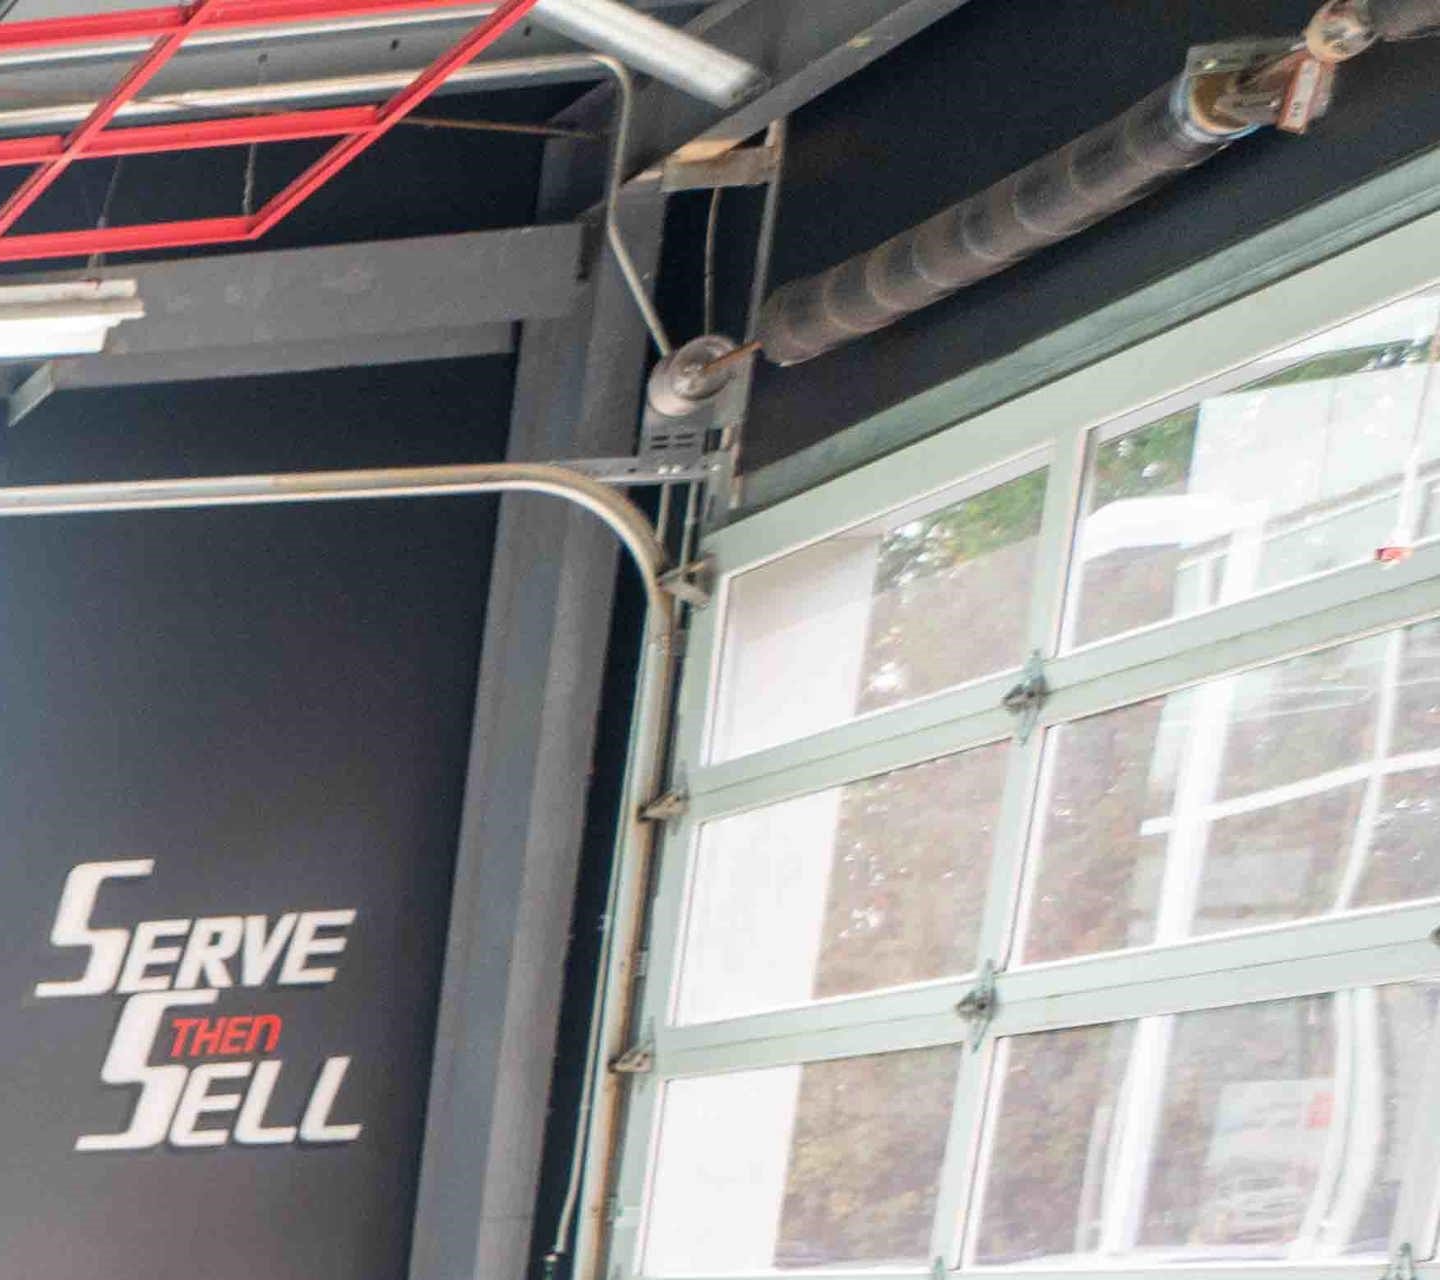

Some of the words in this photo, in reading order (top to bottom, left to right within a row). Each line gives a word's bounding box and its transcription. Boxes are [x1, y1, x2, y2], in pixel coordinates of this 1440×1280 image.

[34, 859, 357, 998] SERVE
[74, 989, 362, 1151] SELL
[170, 1013, 282, 1057] THEN
